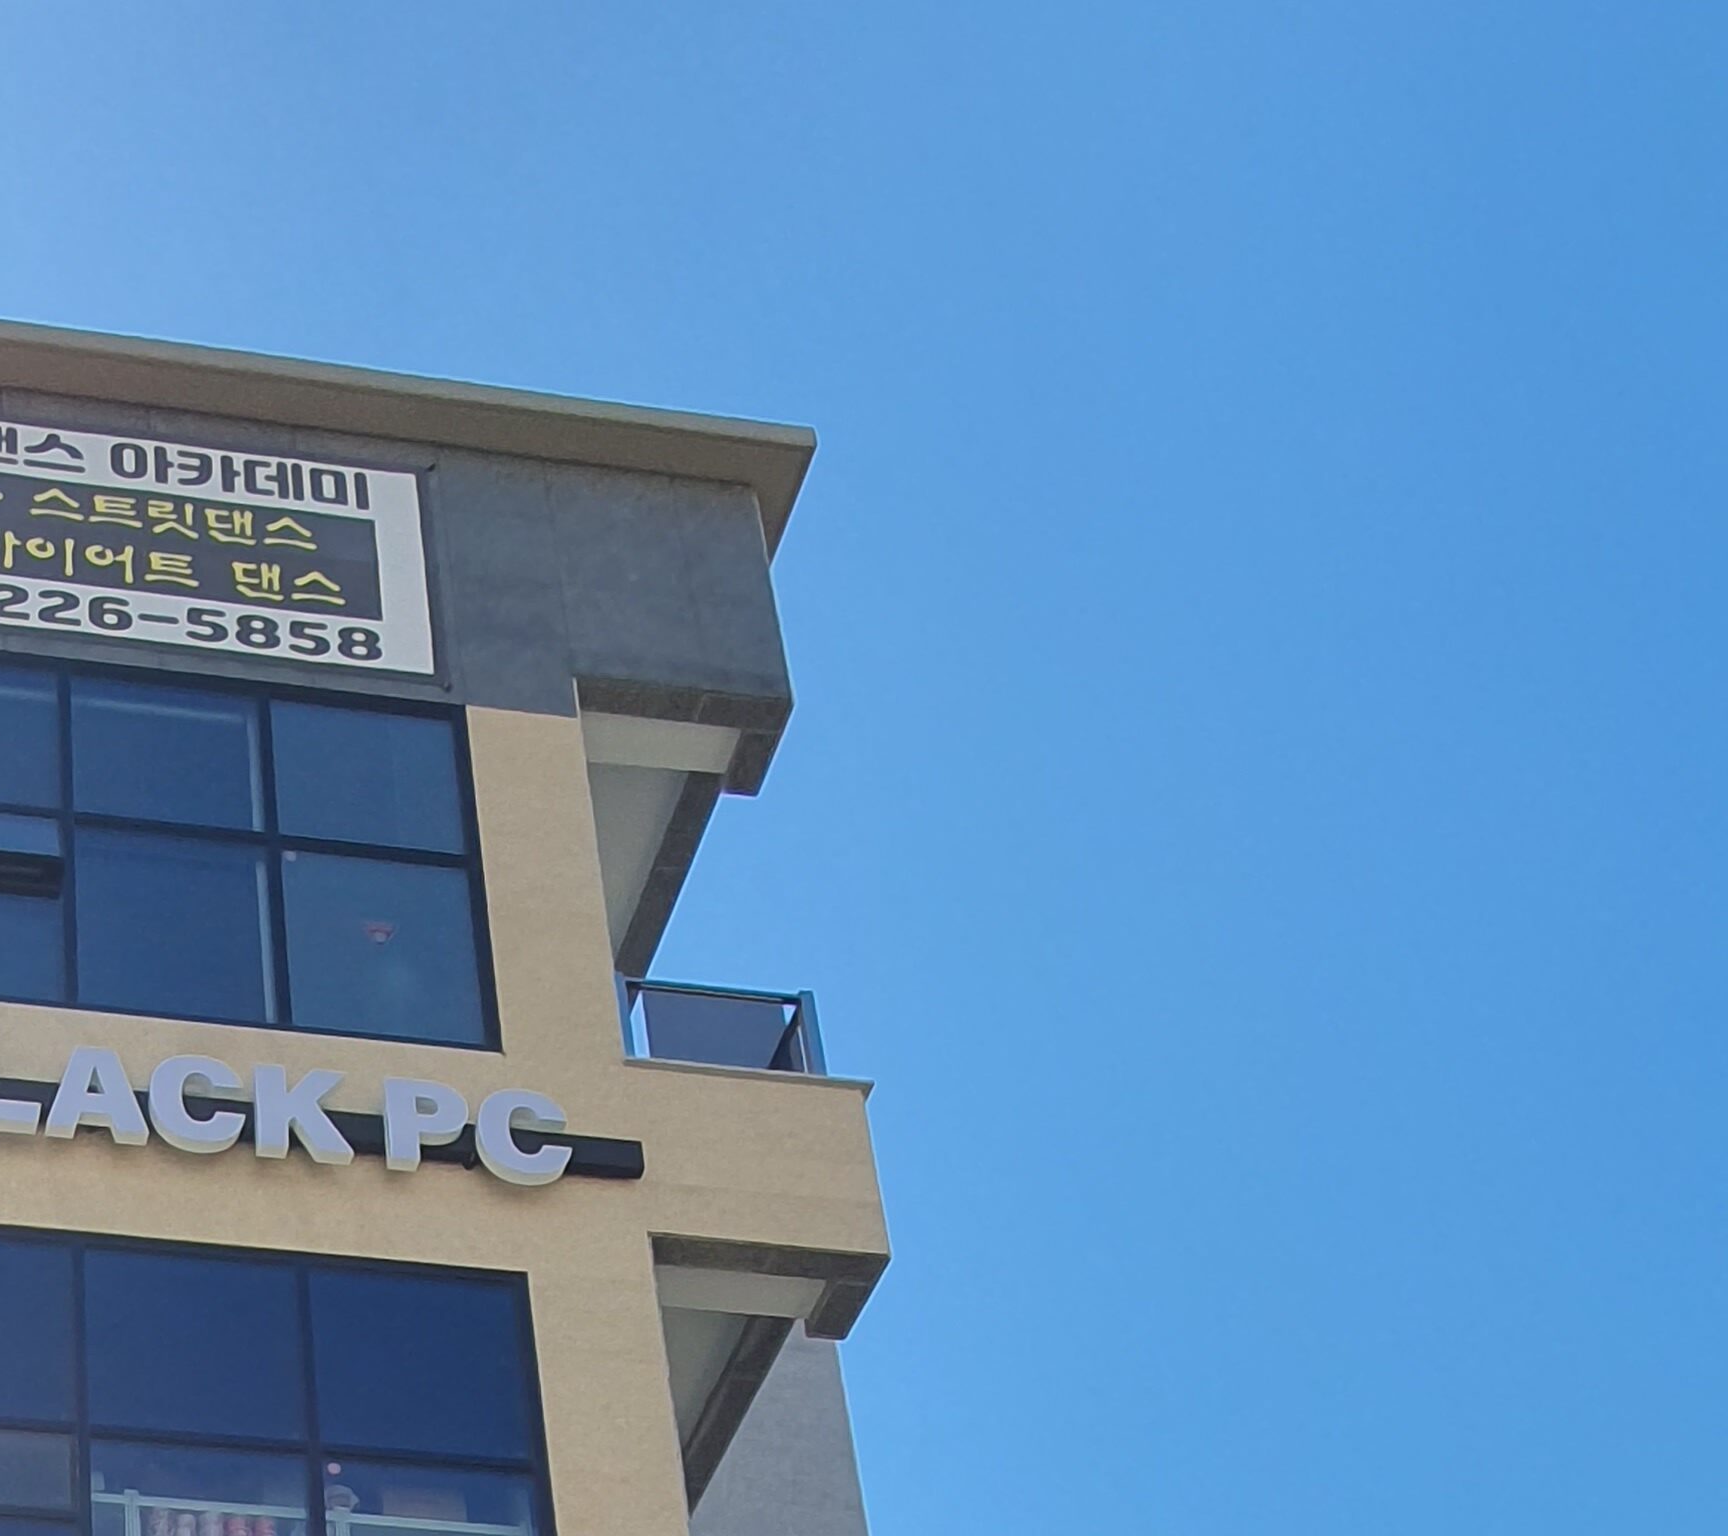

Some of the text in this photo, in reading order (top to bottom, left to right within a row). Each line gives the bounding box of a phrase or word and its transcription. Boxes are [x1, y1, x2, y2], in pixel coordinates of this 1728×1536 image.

[109, 440, 371, 511] 아카데미
[29, 487, 318, 551] 스트릿댄스
[231, 559, 347, 605] 댄스
[384, 1076, 573, 1187] PC
